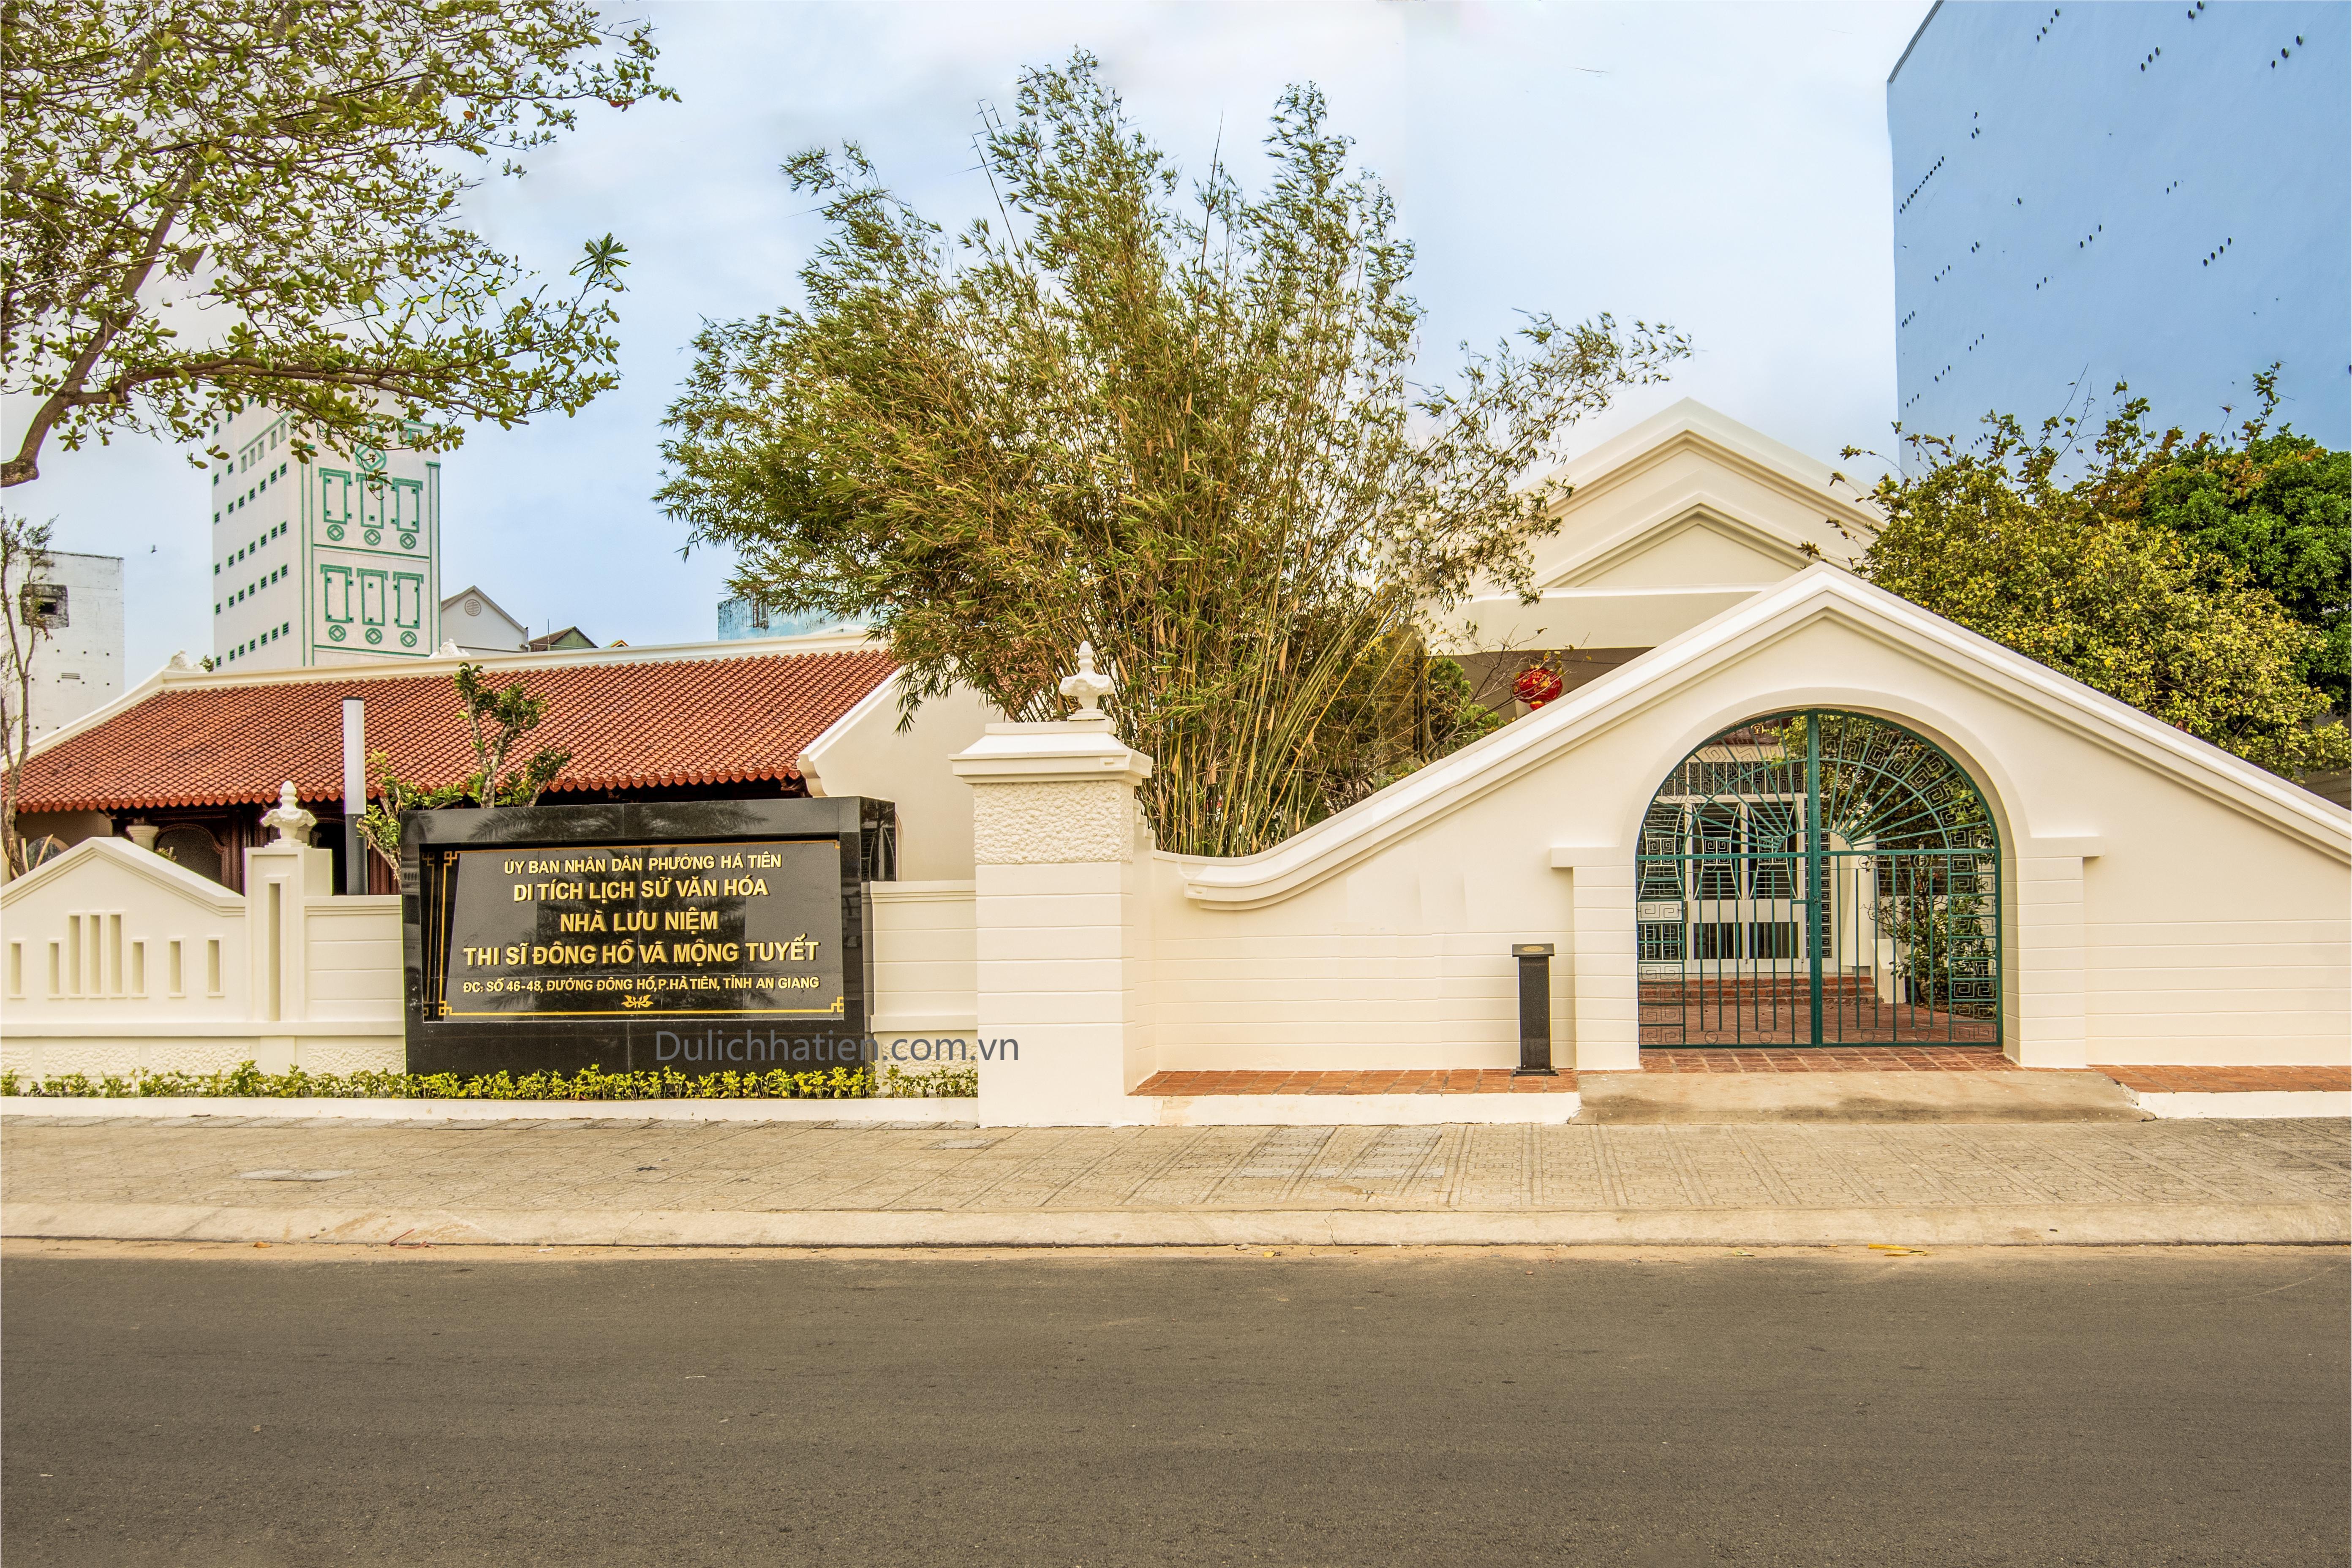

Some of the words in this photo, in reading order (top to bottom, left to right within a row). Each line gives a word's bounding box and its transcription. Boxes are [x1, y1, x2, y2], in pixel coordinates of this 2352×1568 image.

[505, 861, 524, 874] ỦY
[529, 860, 560, 874] BAN
[566, 856, 606, 873] NHÂN
[612, 855, 642, 871] DÂN
[749, 852, 781, 868] TIÊN
[515, 883, 533, 901] DI
[538, 879, 583, 900] TÍCH
[589, 881, 634, 904] LỊCH
[642, 877, 672, 897] SỬ
[676, 876, 717, 897] VĂN
[724, 874, 768, 896] HÓA
[561, 909, 607, 932] NHÀ
[614, 910, 657, 931] LƯU
[665, 906, 718, 934] NIỆM
[464, 947, 499, 965] THI
[506, 942, 529, 965] SĨ
[532, 941, 596, 964] ĐÔNG
[674, 939, 739, 966] MỘNG
[746, 934, 819, 961] TUYẾT
[464, 982, 484, 993] ĐC:
[487, 978, 504, 992] SỐ
[507, 980, 543, 992] 46-48,
[596, 977, 633, 991] ĐÔNG
[690, 976, 720, 991] TIÊN,
[723, 975, 752, 989] TỈNH
[756, 977, 774, 989] AN
[779, 977, 819, 988] GIANG
